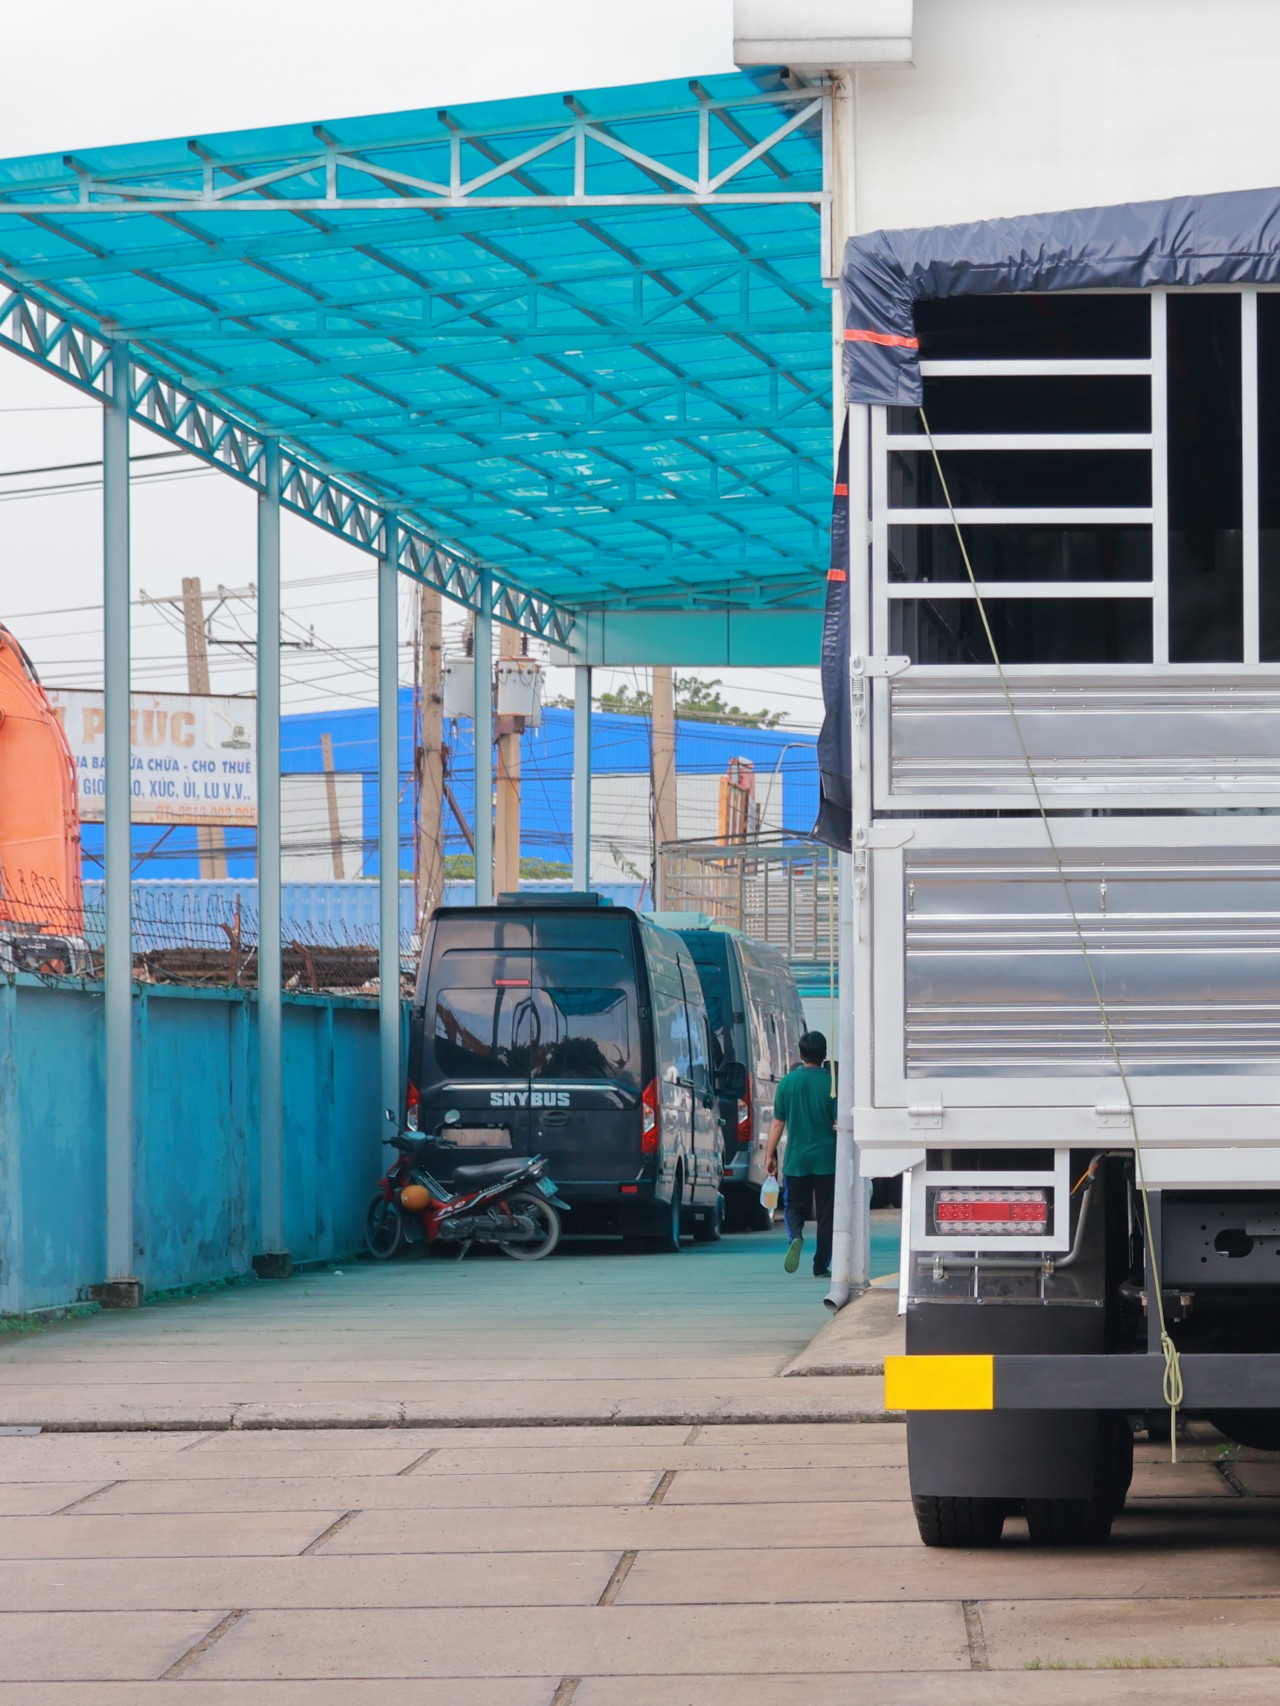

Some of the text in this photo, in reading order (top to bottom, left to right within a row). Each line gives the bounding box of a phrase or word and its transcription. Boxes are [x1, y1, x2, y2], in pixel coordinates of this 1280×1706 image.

[191, 759, 216, 773] CHO
[222, 758, 251, 774] THUÊ
[204, 782, 220, 799] LU
[489, 1091, 571, 1107] SKYBUS
